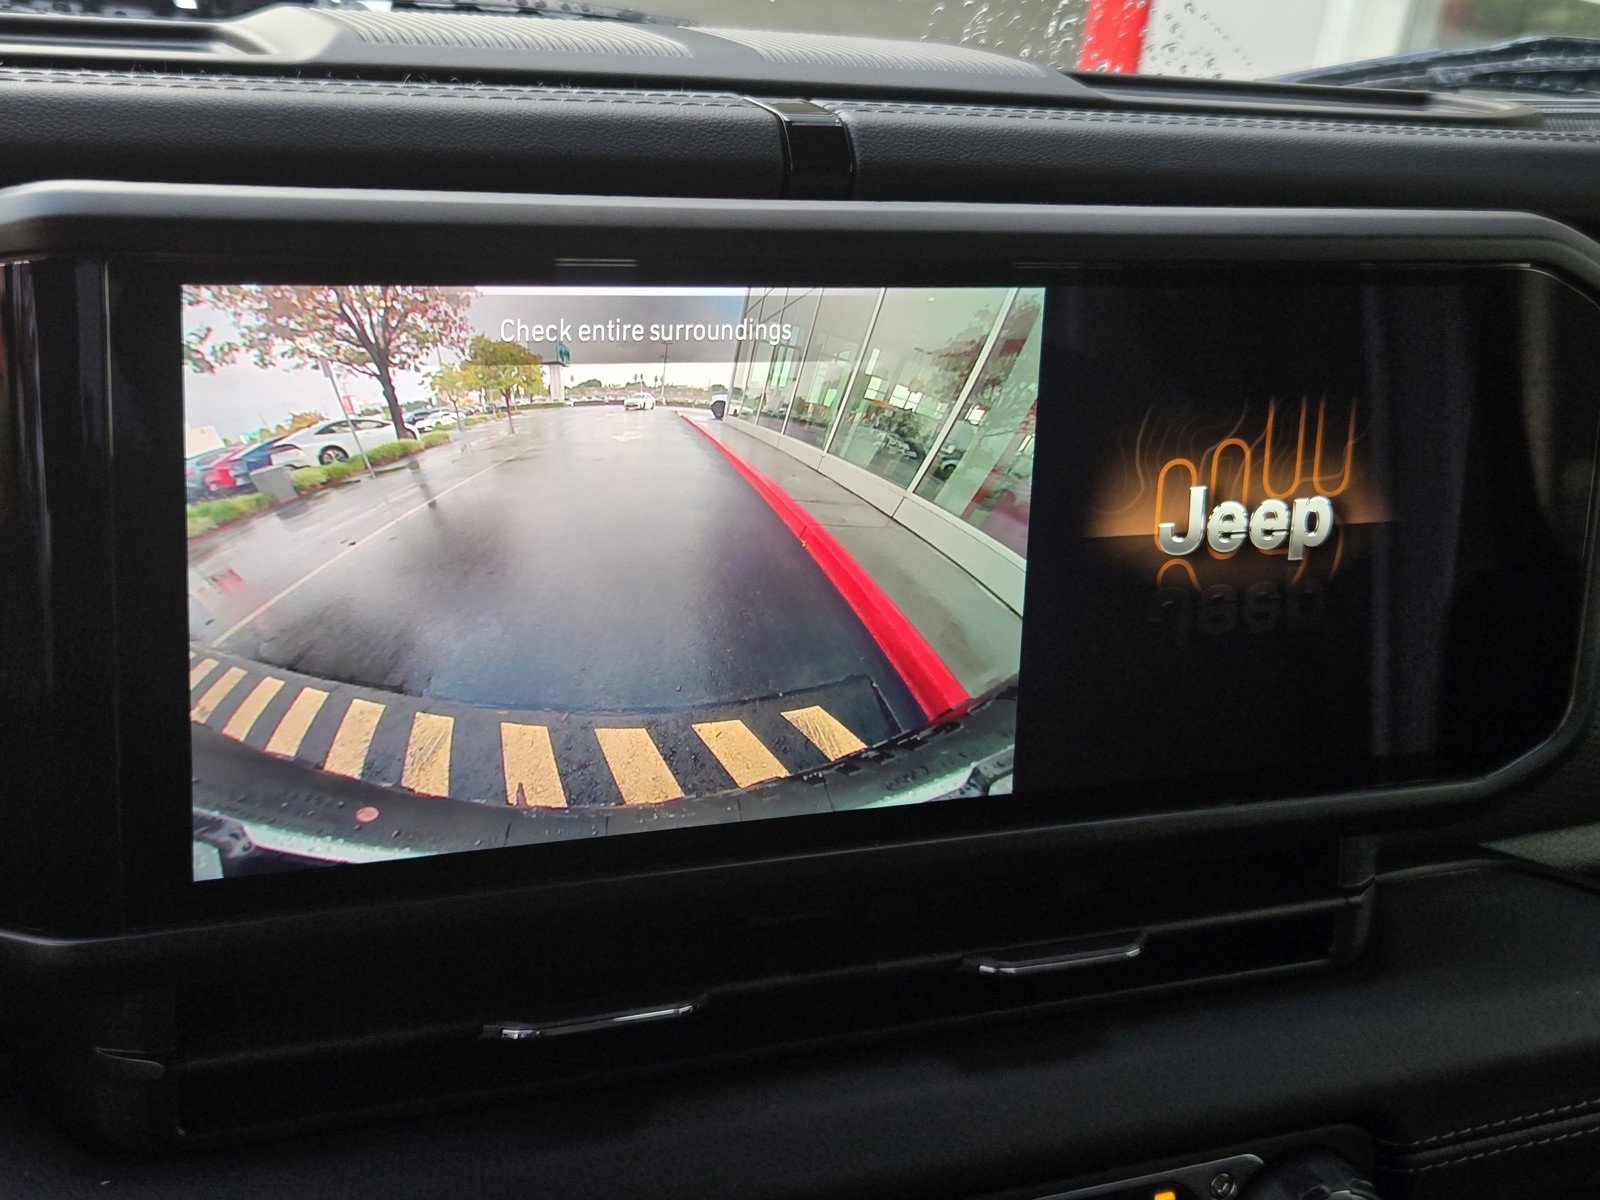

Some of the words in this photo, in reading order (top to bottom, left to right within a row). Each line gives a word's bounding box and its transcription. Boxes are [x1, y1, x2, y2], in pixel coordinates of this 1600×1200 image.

[500, 318, 572, 343] Check
[578, 318, 644, 342] entire
[649, 318, 792, 345] surroundings
[1158, 485, 1334, 561] Jeep
